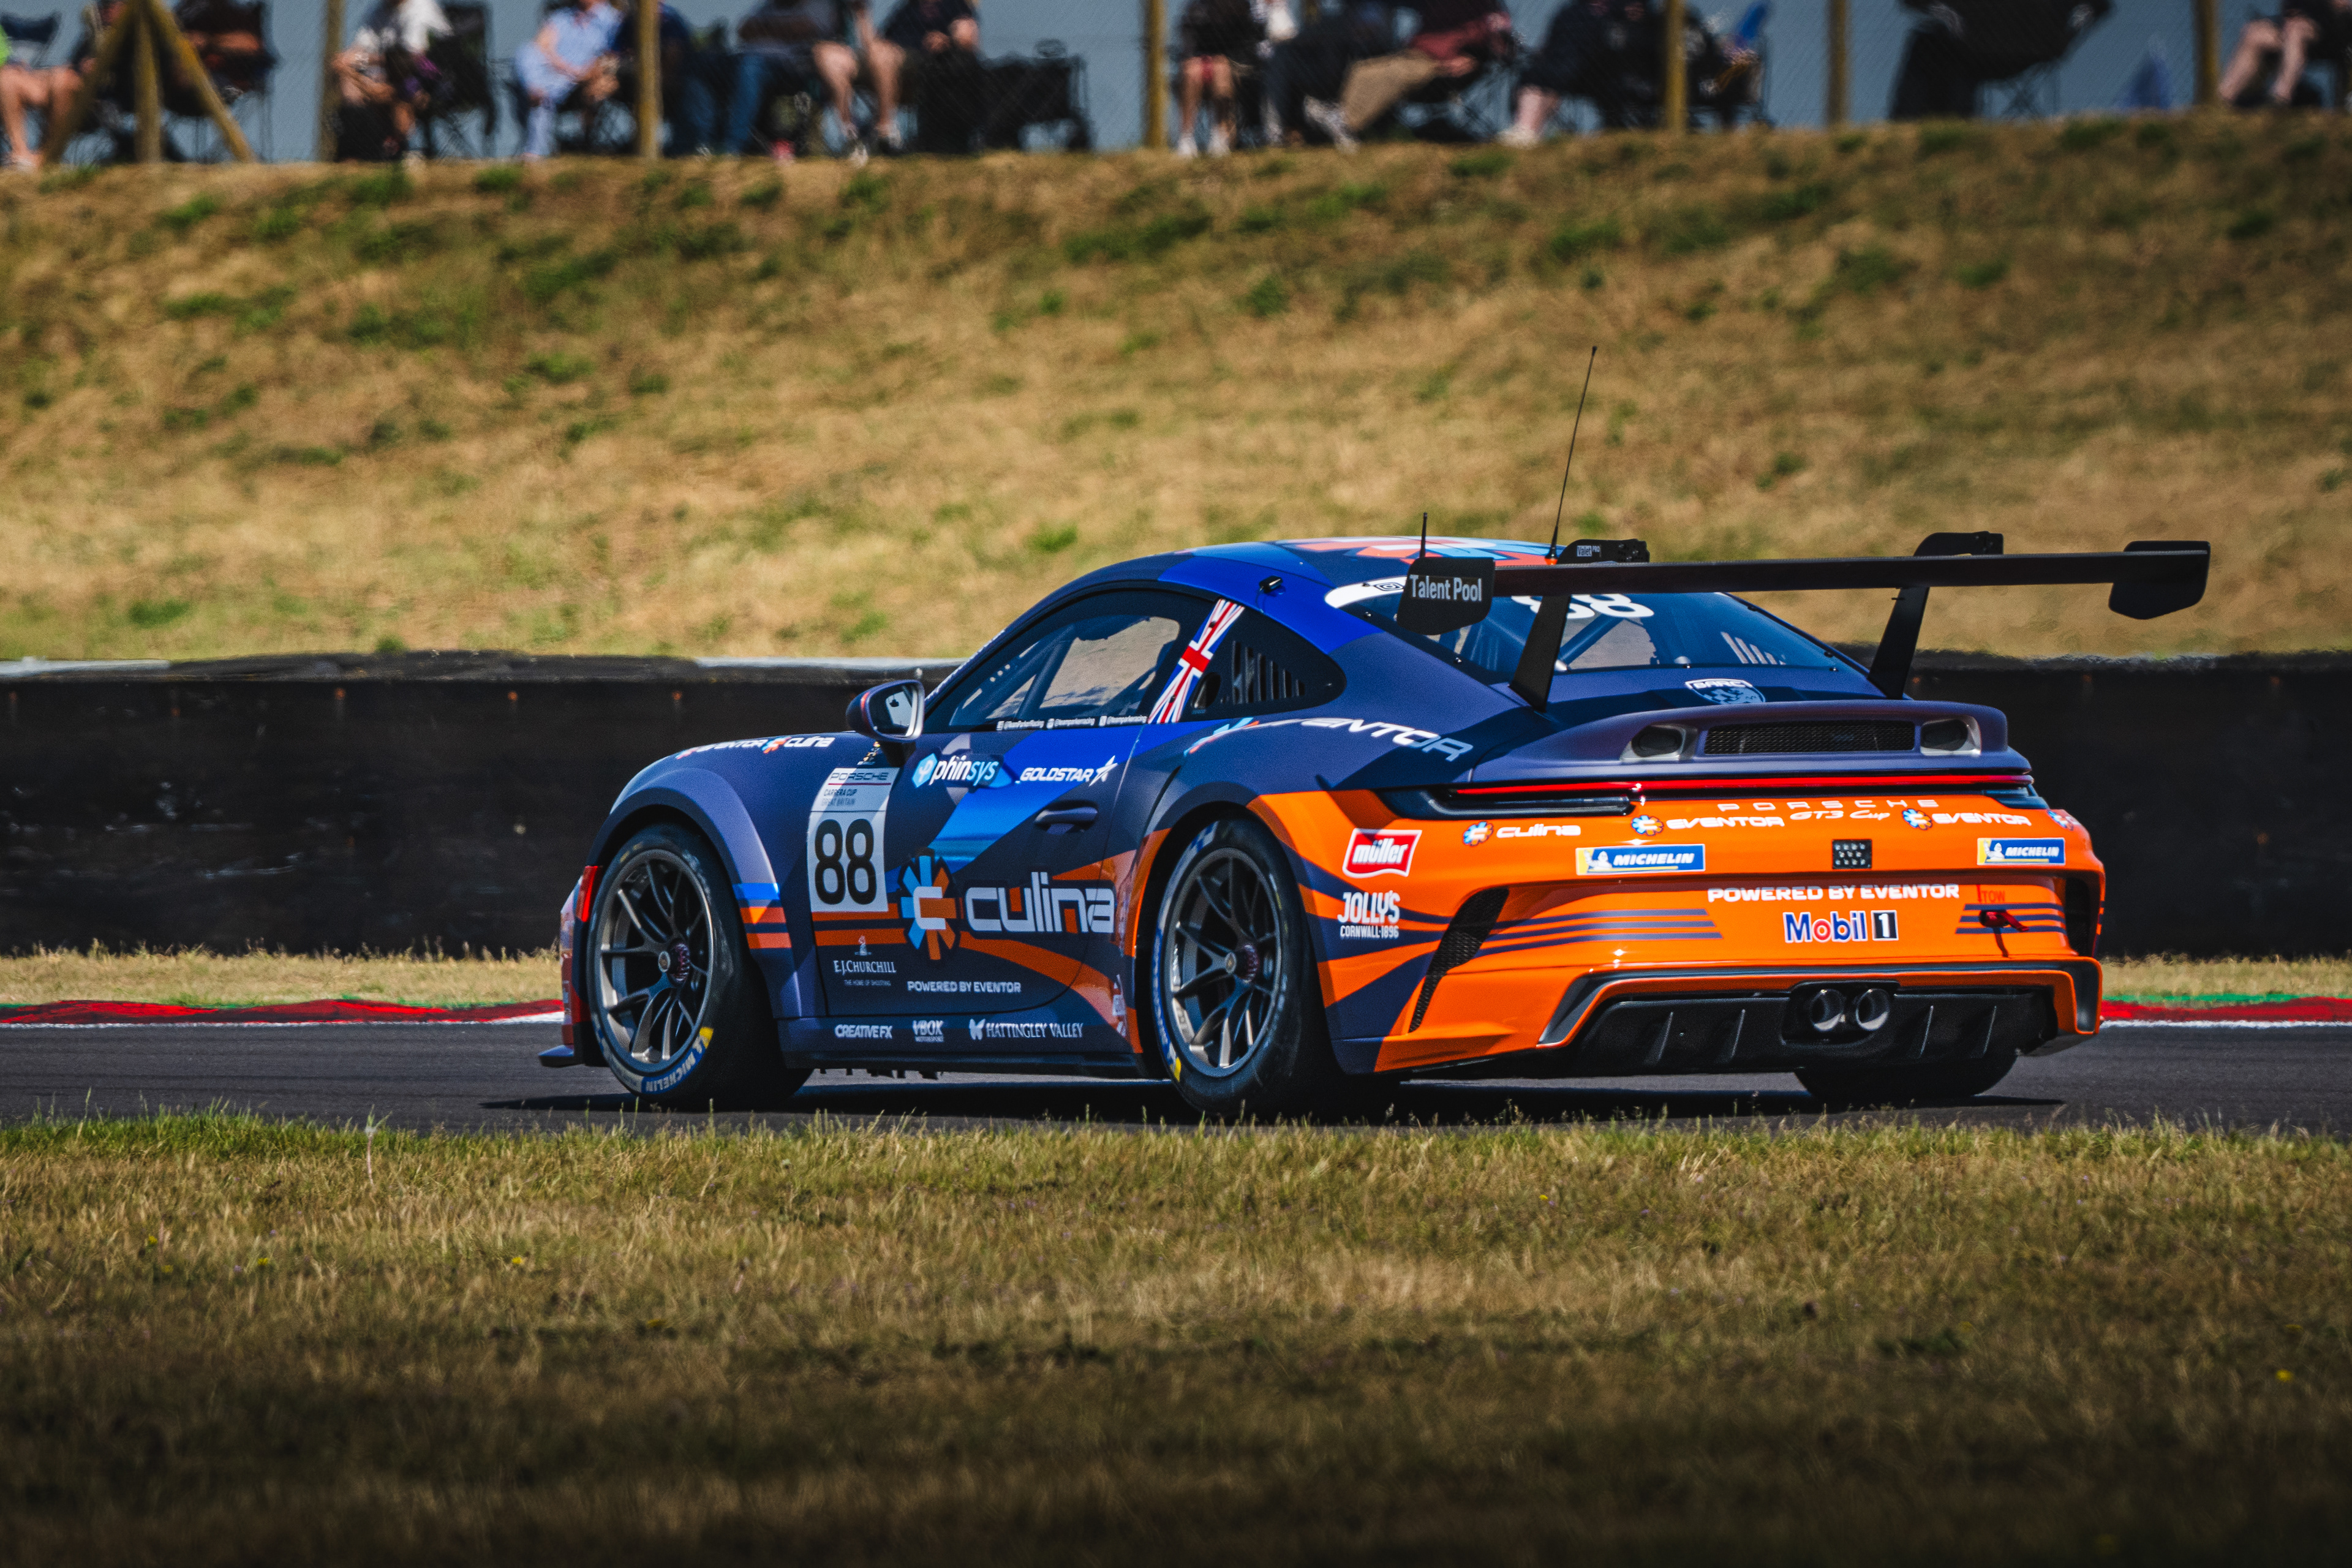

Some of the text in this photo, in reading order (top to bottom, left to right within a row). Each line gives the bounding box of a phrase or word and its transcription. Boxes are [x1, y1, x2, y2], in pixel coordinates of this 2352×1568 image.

[1409, 575, 1482, 602] Talent Pool
[1693, 680, 1746, 689] BARC
[783, 736, 835, 747] culina
[831, 772, 889, 781] PORSCHE
[929, 755, 1000, 786] phinsys
[1020, 767, 1095, 782] GOLDSTAR
[1717, 799, 1939, 812] PORSCHE
[1790, 810, 1890, 821] GT3 Cup
[1932, 812, 2032, 826] EVENTOR
[1666, 817, 1785, 829] EVENTOR
[1496, 824, 1581, 838] culina
[1352, 838, 1408, 864] müller
[2005, 846, 2059, 857] MICHELIN
[815, 819, 877, 905] 88
[1613, 853, 1695, 866] MICHELIN
[1708, 884, 1959, 902] POWERED BY EVENTOR
[1981, 891, 2005, 903] TOW
[965, 872, 1115, 933] culina
[1337, 890, 1401, 924] JOLLY'S
[1783, 910, 1892, 943] Mobil 1
[907, 981, 1022, 993] POWERED BY EVENTOR
[912, 1020, 944, 1036] VBOX
[986, 1022, 1084, 1038] HATTINGLEY VALLEY
[645, 1052, 696, 1092] MICHELIN
